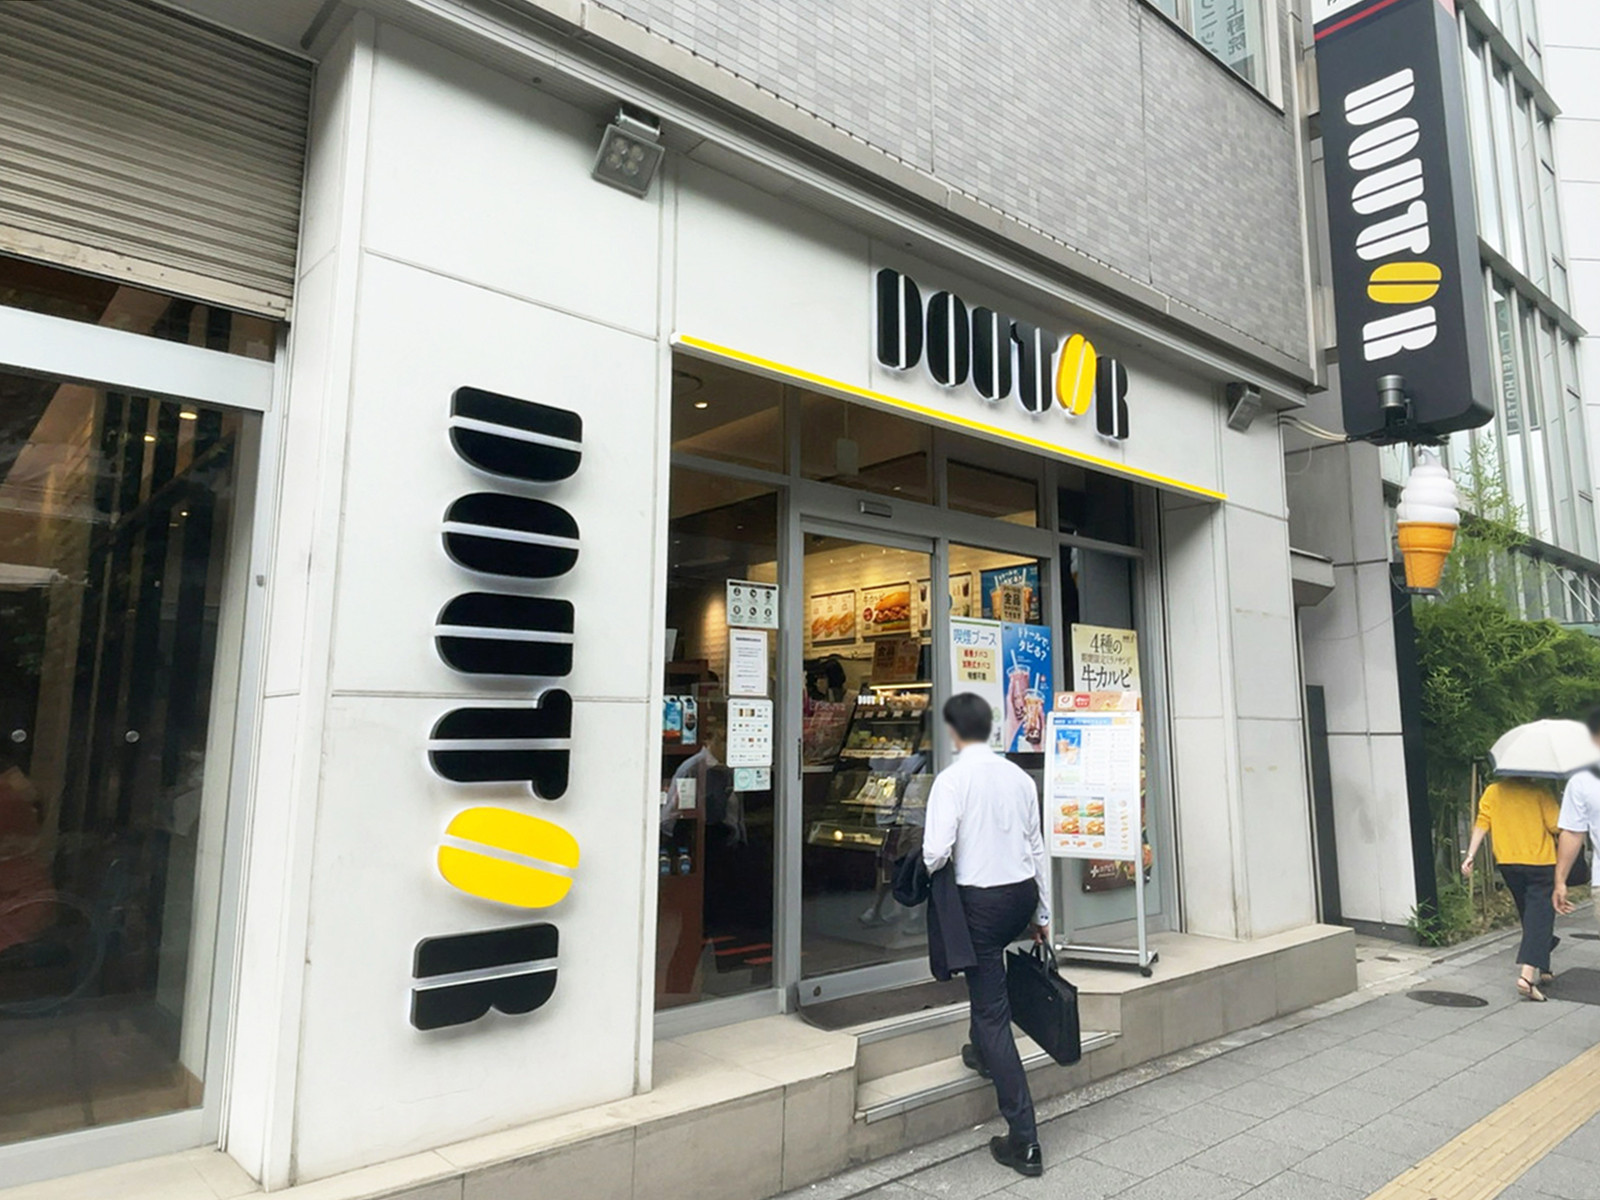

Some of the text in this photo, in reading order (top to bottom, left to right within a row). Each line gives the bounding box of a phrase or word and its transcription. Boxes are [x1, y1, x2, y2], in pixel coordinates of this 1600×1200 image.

[1344, 67, 1442, 362] DOUTOR
[877, 267, 1130, 441] DOUTOR
[953, 628, 998, 646] 喫煙ブース
[1081, 664, 1133, 691] 牛カルビ
[1089, 633, 1123, 655] 4種の
[410, 385, 584, 1031] DOUTOR
